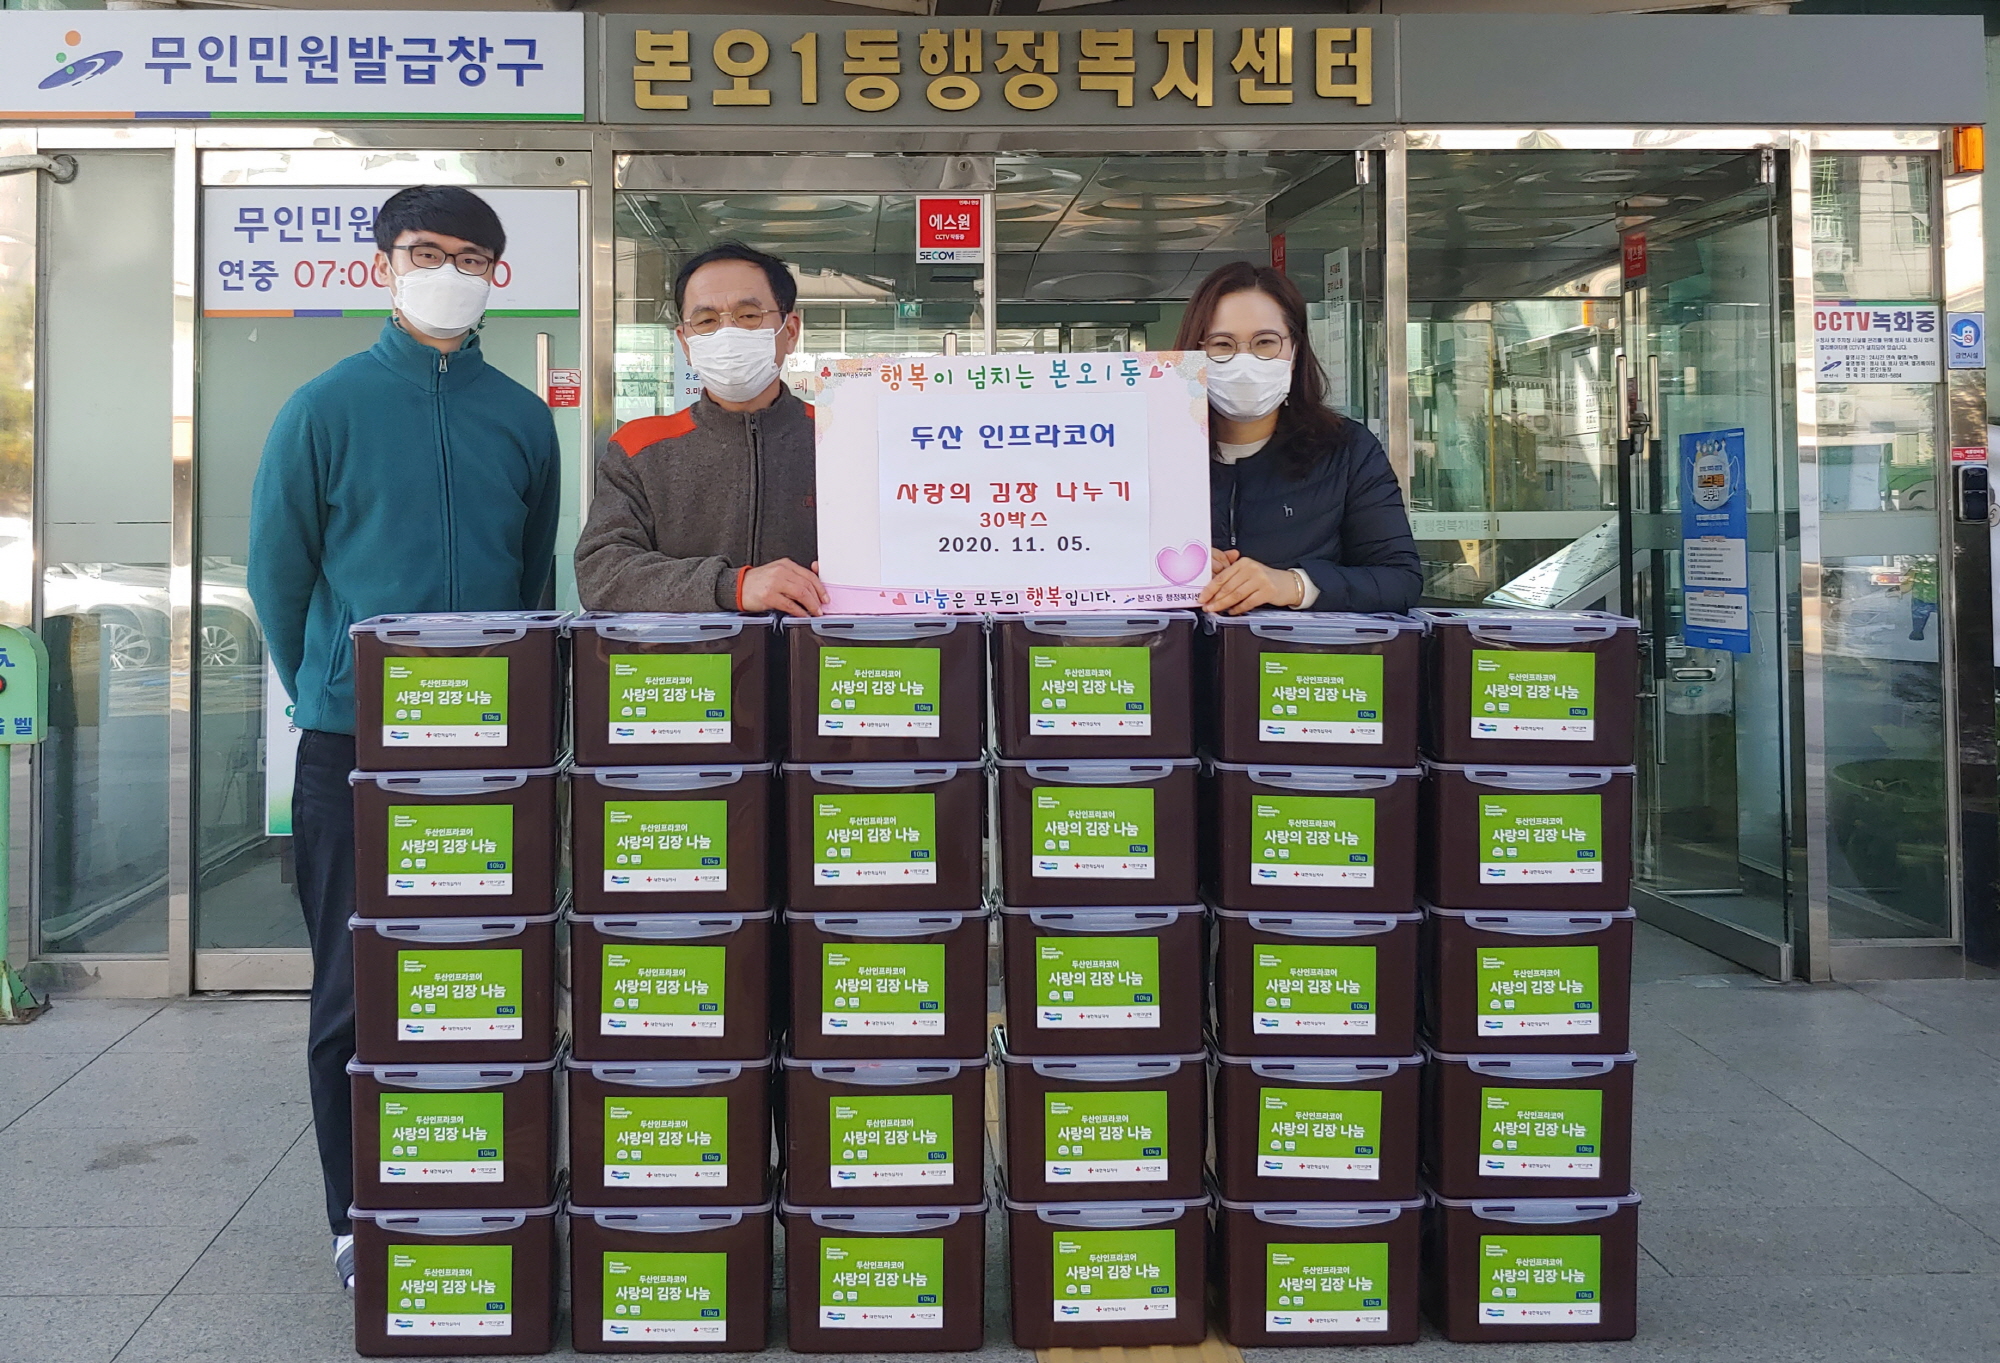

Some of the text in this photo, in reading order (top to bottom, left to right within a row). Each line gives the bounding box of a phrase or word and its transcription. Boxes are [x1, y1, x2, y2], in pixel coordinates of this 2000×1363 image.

[145, 35, 544, 87] 무인민원발급창구
[928, 214, 970, 230] 에스원
[920, 250, 954, 260] SECOM
[218, 259, 280, 292] 연중
[1814, 311, 1935, 332] CCTV녹화중
[880, 362, 953, 391] 행복이
[967, 365, 1035, 390] 넘치는
[910, 422, 1115, 450] 두산 인프라코어
[897, 481, 1130, 504] 사랑의 김장 나누기
[979, 512, 1048, 528] 30박스
[938, 536, 1090, 552] 2020. 11. 05.
[914, 586, 1116, 608] 나눔은 모두의 행복입니다.
[1138, 594, 1163, 602] 본오1동
[854, 670, 902, 679] 두산인프라코어
[1065, 669, 1113, 677] 두산인프라코어
[1508, 673, 1556, 682] 두산인프라코어
[419, 680, 467, 688] 두산인프라코어
[645, 677, 693, 685] 두산인프라코어
[831, 680, 924, 695] 사랑의 김장 나눔
[1042, 680, 1134, 694] 사랑의 김장 나눔
[1296, 676, 1344, 686] 두산인프라코어
[396, 691, 492, 704] 사랑의 김장 나눔
[622, 688, 715, 702] 사랑의 김장 나눔
[1272, 686, 1367, 702] 사랑의 김장 나눔
[1485, 684, 1579, 699] 사랑의 김장 나눔
[827, 828, 920, 843] 사랑의 김장 나눔
[1045, 821, 1138, 836] 사랑의 김장 나눔
[1492, 828, 1586, 842] 사랑의 김장 나눔
[617, 835, 711, 850] 사랑의 김장 나눔
[1264, 830, 1358, 845] 사랑의 김장 나눔
[401, 839, 496, 854] 사랑의 김장 나눔
[835, 978, 929, 992] 사랑의 김장 나눔
[1049, 972, 1142, 986] 사랑의 김장 나눔
[411, 984, 506, 998] 사랑의 김장 나눔
[614, 980, 708, 994] 사랑의 김장 나눔
[1266, 979, 1360, 994] 사랑의 김장 나눔
[1490, 980, 1583, 995] 사랑의 김장 나눔
[392, 1127, 487, 1141] 사랑의 김장 나눔
[1058, 1126, 1152, 1140] 사랑의 김장 나눔
[1272, 1122, 1364, 1138] 사랑의 김장 나눔
[1493, 1122, 1586, 1137] 사랑의 김장 나눔
[617, 1132, 711, 1145] 사랑의 김장 나눔
[843, 1130, 937, 1145] 사랑의 김장 나눔
[833, 1272, 927, 1286] 사랑의 김장 나눔
[1066, 1264, 1160, 1280] 사랑의 김장 나눔
[1492, 1269, 1585, 1283] 사랑의 김장 나눔
[401, 1280, 496, 1294] 사랑의 김장 나눔
[1280, 1277, 1372, 1291] 사랑의 김장 나눔
[616, 1286, 710, 1300] 사랑의 김장 나눔
